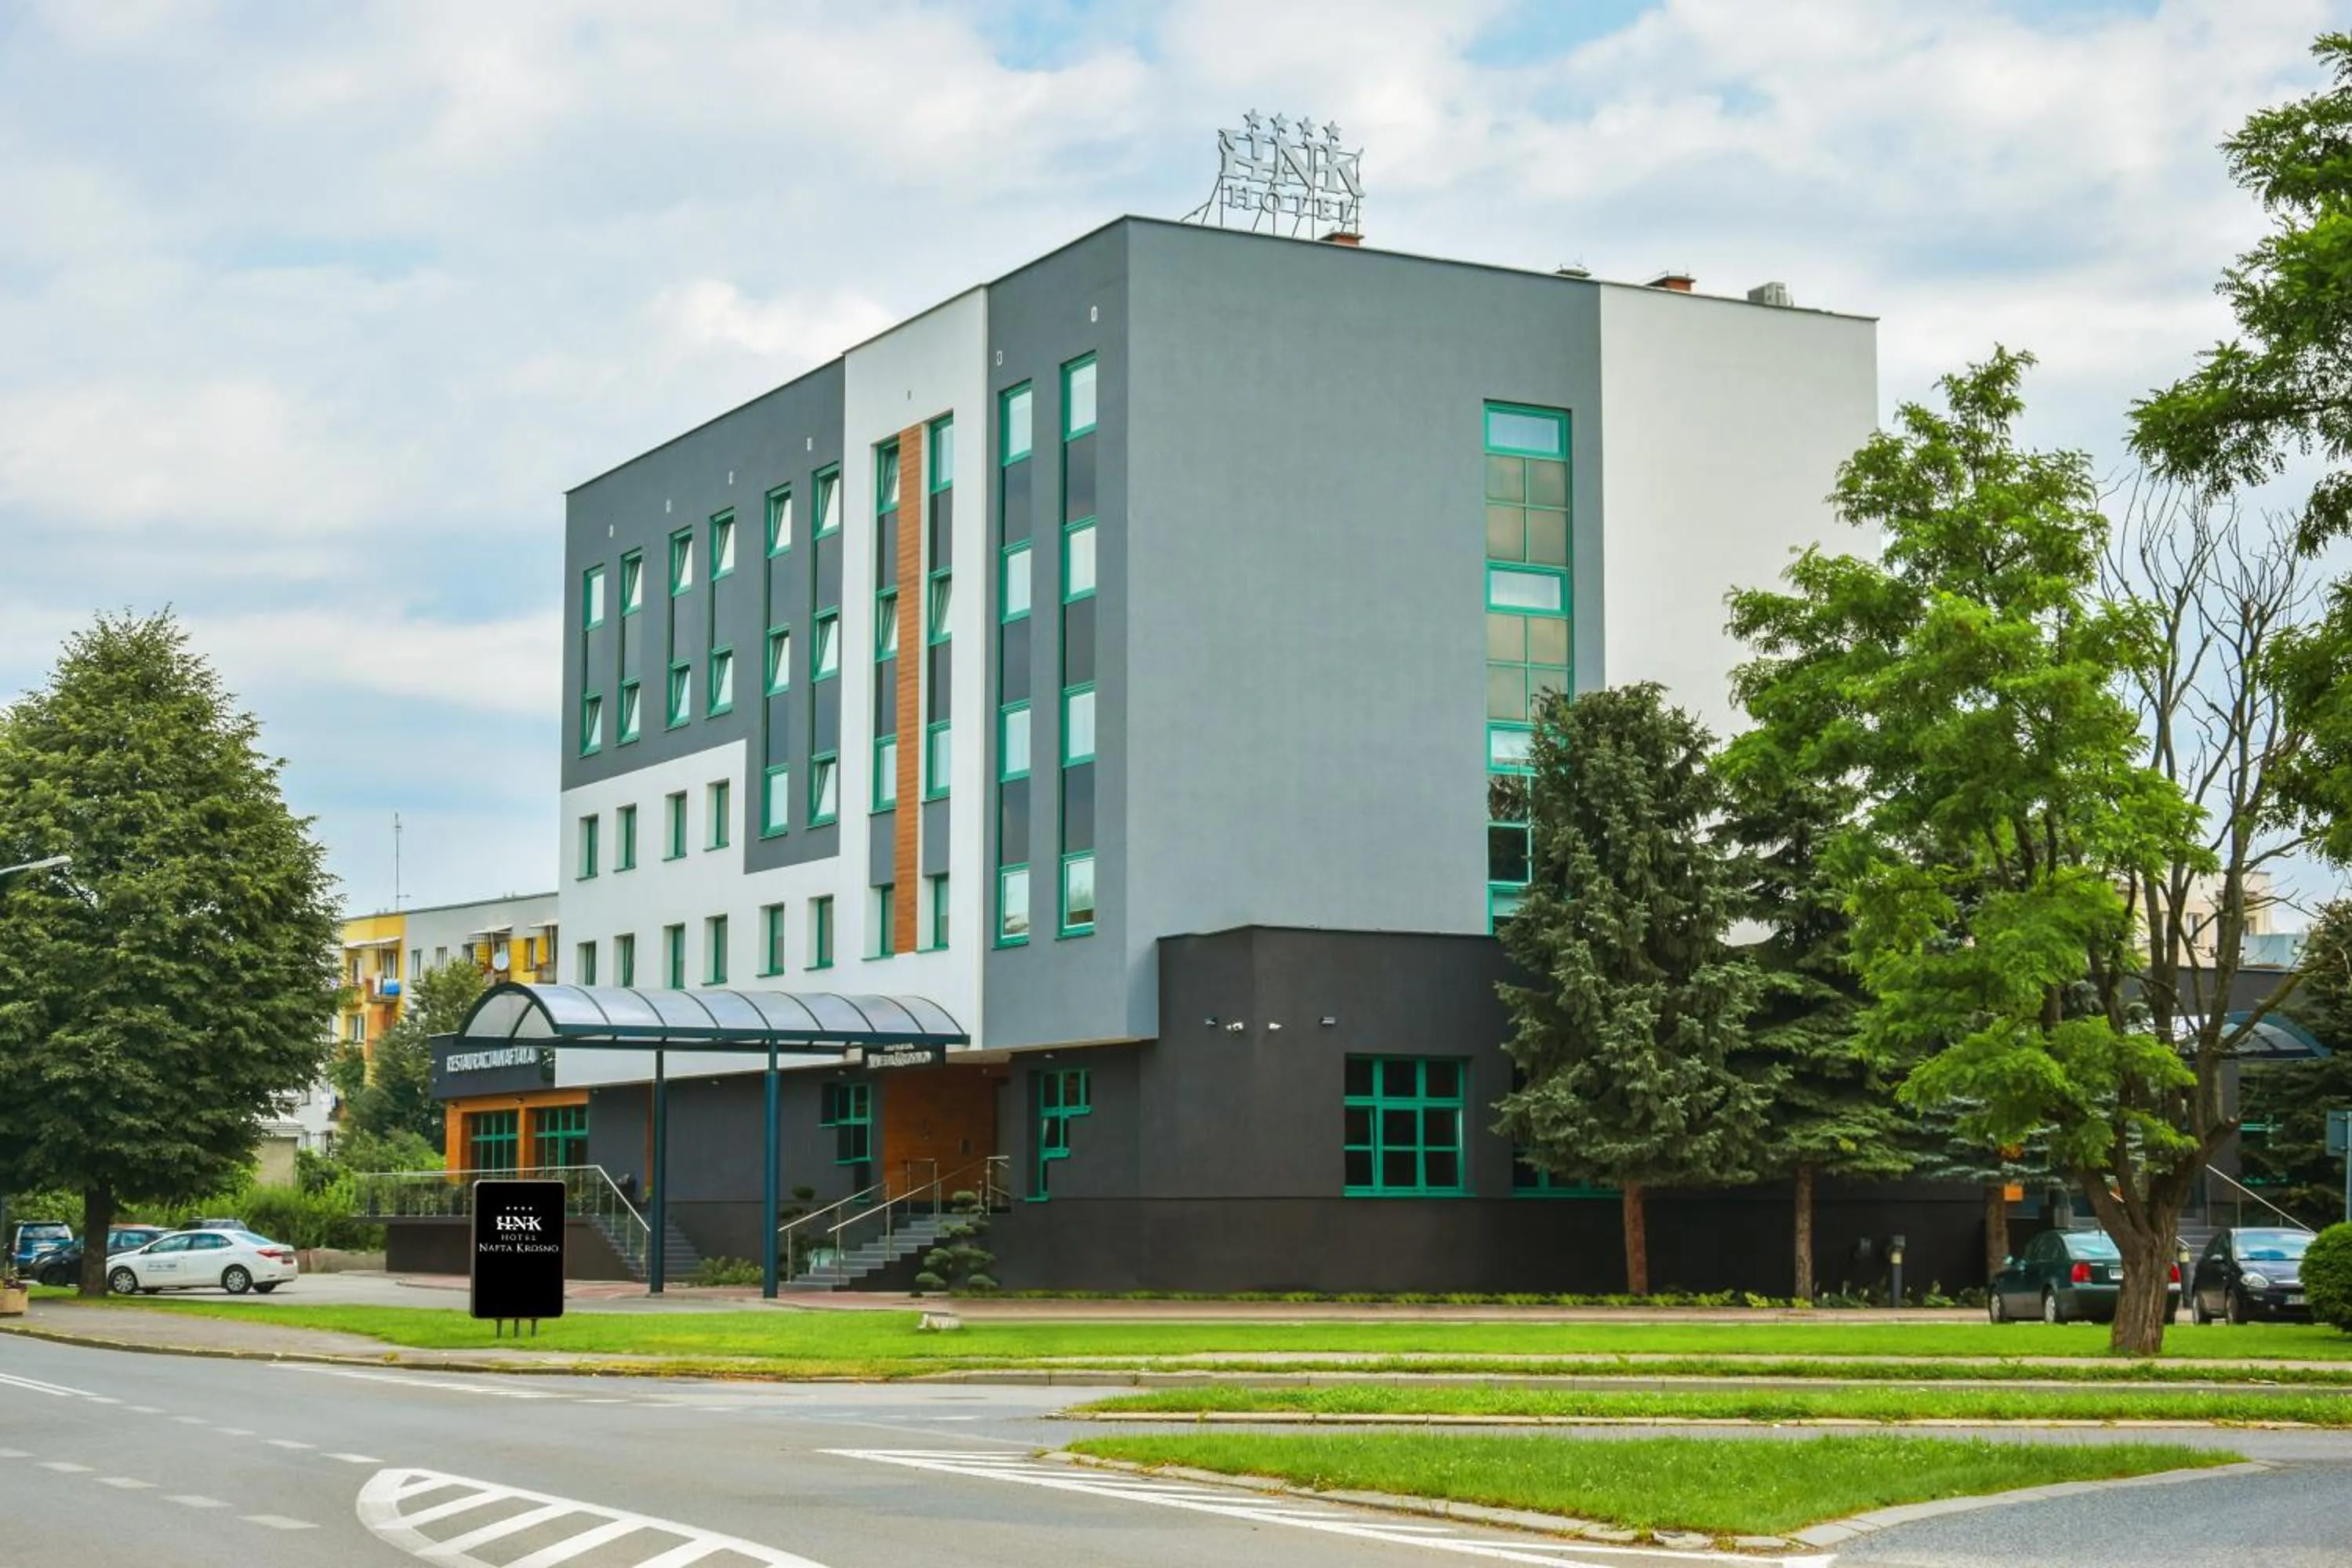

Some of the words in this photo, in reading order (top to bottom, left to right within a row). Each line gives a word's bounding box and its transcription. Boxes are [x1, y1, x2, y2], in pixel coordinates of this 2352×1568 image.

[1218, 129, 1366, 198] HNK
[1228, 184, 1353, 224] HOTEL
[495, 1215, 543, 1232] HNK
